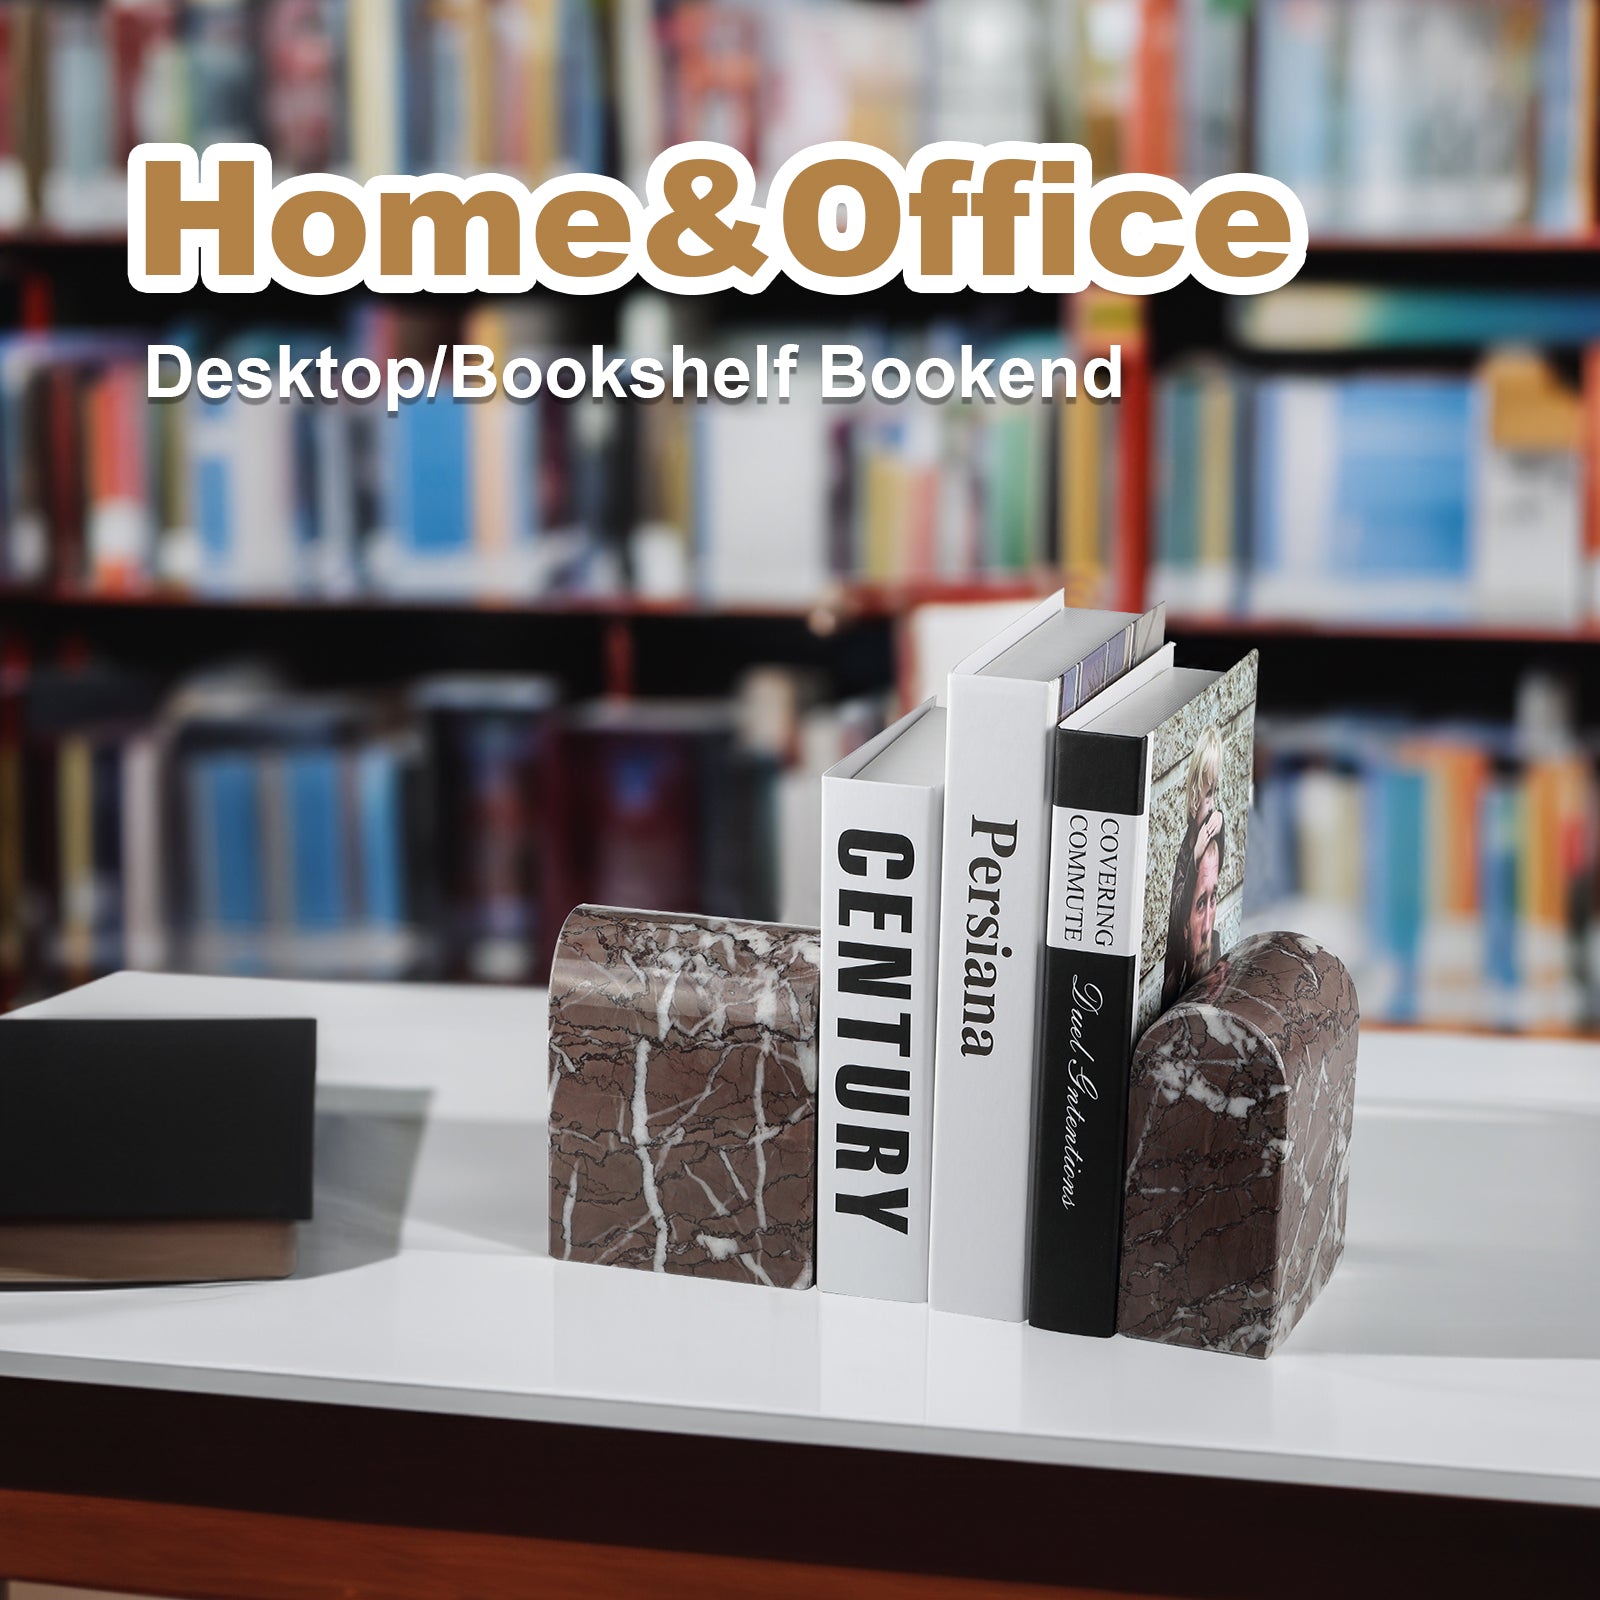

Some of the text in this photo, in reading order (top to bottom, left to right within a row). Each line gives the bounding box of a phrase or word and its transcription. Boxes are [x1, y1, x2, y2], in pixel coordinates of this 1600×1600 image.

[959, 813, 1019, 1058] Persiana
[1063, 813, 1089, 942] COMMUTE
[1094, 817, 1120, 947] COVERING
[834, 828, 916, 1236] CENTURY
[1069, 973, 1104, 1062] Duel
